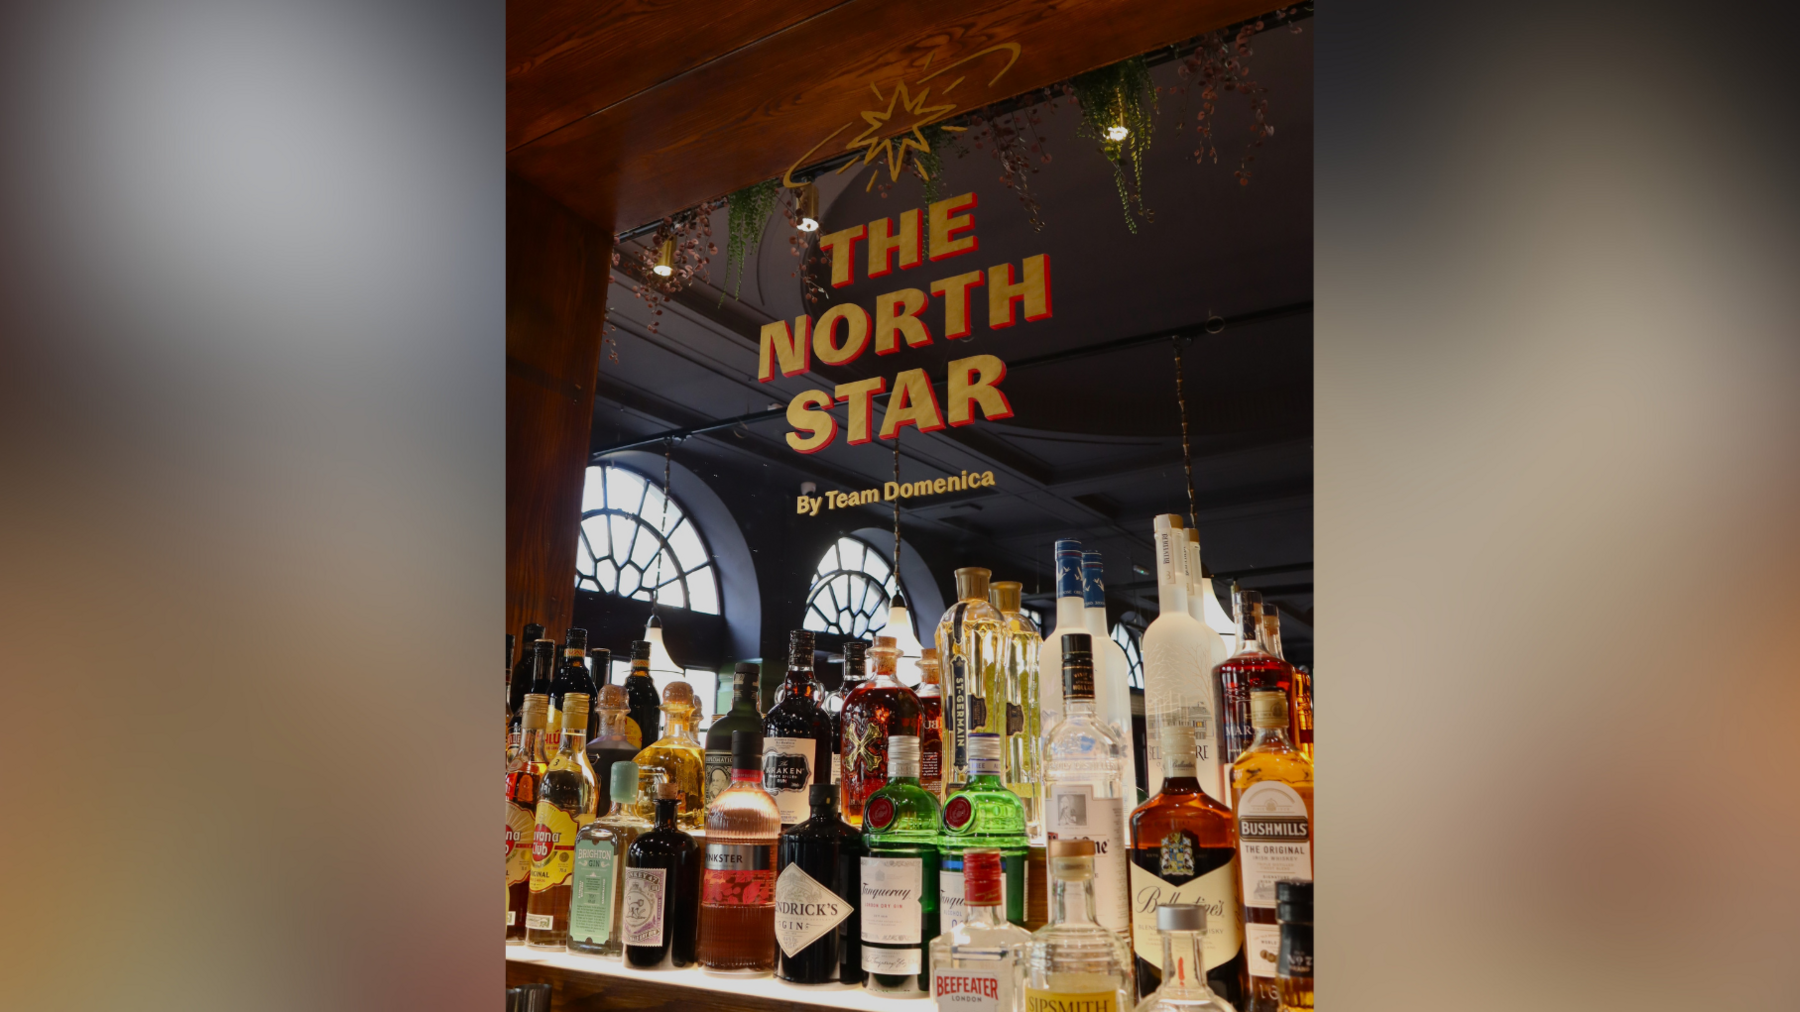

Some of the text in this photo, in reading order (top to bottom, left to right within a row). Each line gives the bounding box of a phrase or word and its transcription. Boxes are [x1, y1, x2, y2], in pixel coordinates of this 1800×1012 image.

[820, 191, 978, 289] THE
[758, 253, 1053, 384] NORTH
[785, 354, 1015, 454] STAR
[796, 470, 996, 516] By Team Domenica
[955, 677, 965, 747] ST-GERMAIN
[766, 767, 802, 775] KRAKEN
[1241, 821, 1307, 836] BUSHMILLS
[578, 849, 612, 860] BRIGHTON
[1245, 845, 1305, 855] THE ORIGINAL
[861, 882, 911, 901] Tanqueray
[940, 889, 964, 910] Tanqu
[775, 901, 838, 916] NDRICK'S
[781, 920, 804, 931] GIN
[936, 975, 999, 1001] BEEFEATER
[1028, 996, 1108, 1012] SIPSMITH
